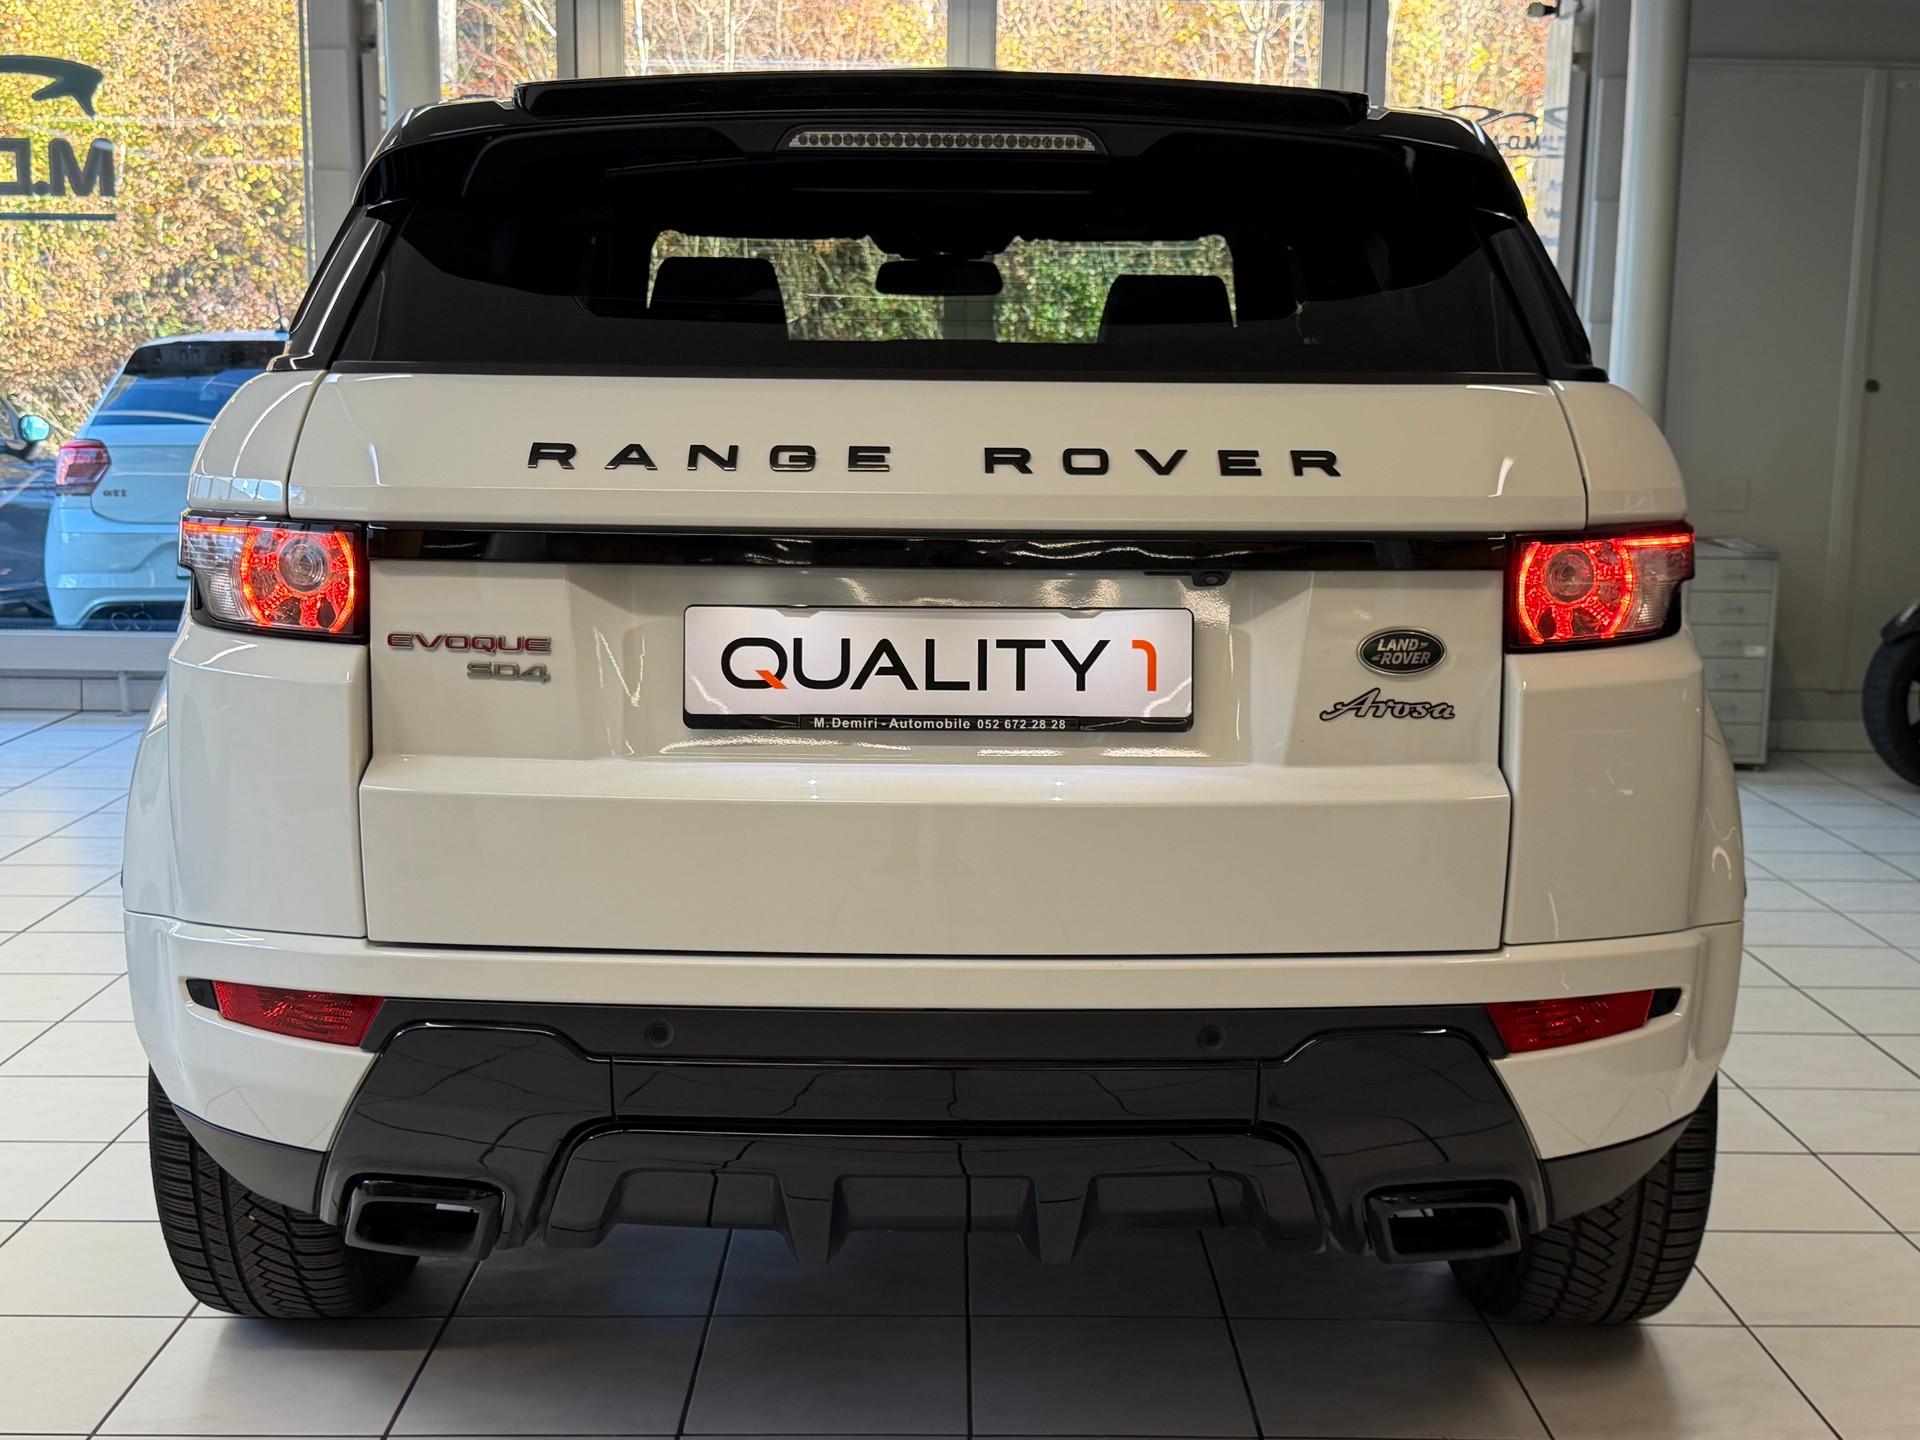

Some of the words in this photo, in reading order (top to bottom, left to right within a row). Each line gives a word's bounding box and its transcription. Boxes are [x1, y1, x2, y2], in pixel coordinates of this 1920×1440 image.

[527, 441, 891, 472] RANGE
[984, 447, 1342, 477] ROVER
[387, 632, 551, 656] EVOQUE
[1377, 638, 1419, 652] LAND
[720, 637, 1112, 692] QUALITY
[1380, 651, 1432, 665] ROVER
[466, 660, 551, 684] SD4
[1319, 687, 1456, 722] Arosa
[889, 717, 970, 729] Automobile
[976, 719, 1000, 730] 052
[1004, 719, 1027, 730] 672
[1031, 719, 1046, 730] 28
[1051, 719, 1067, 730] 28
